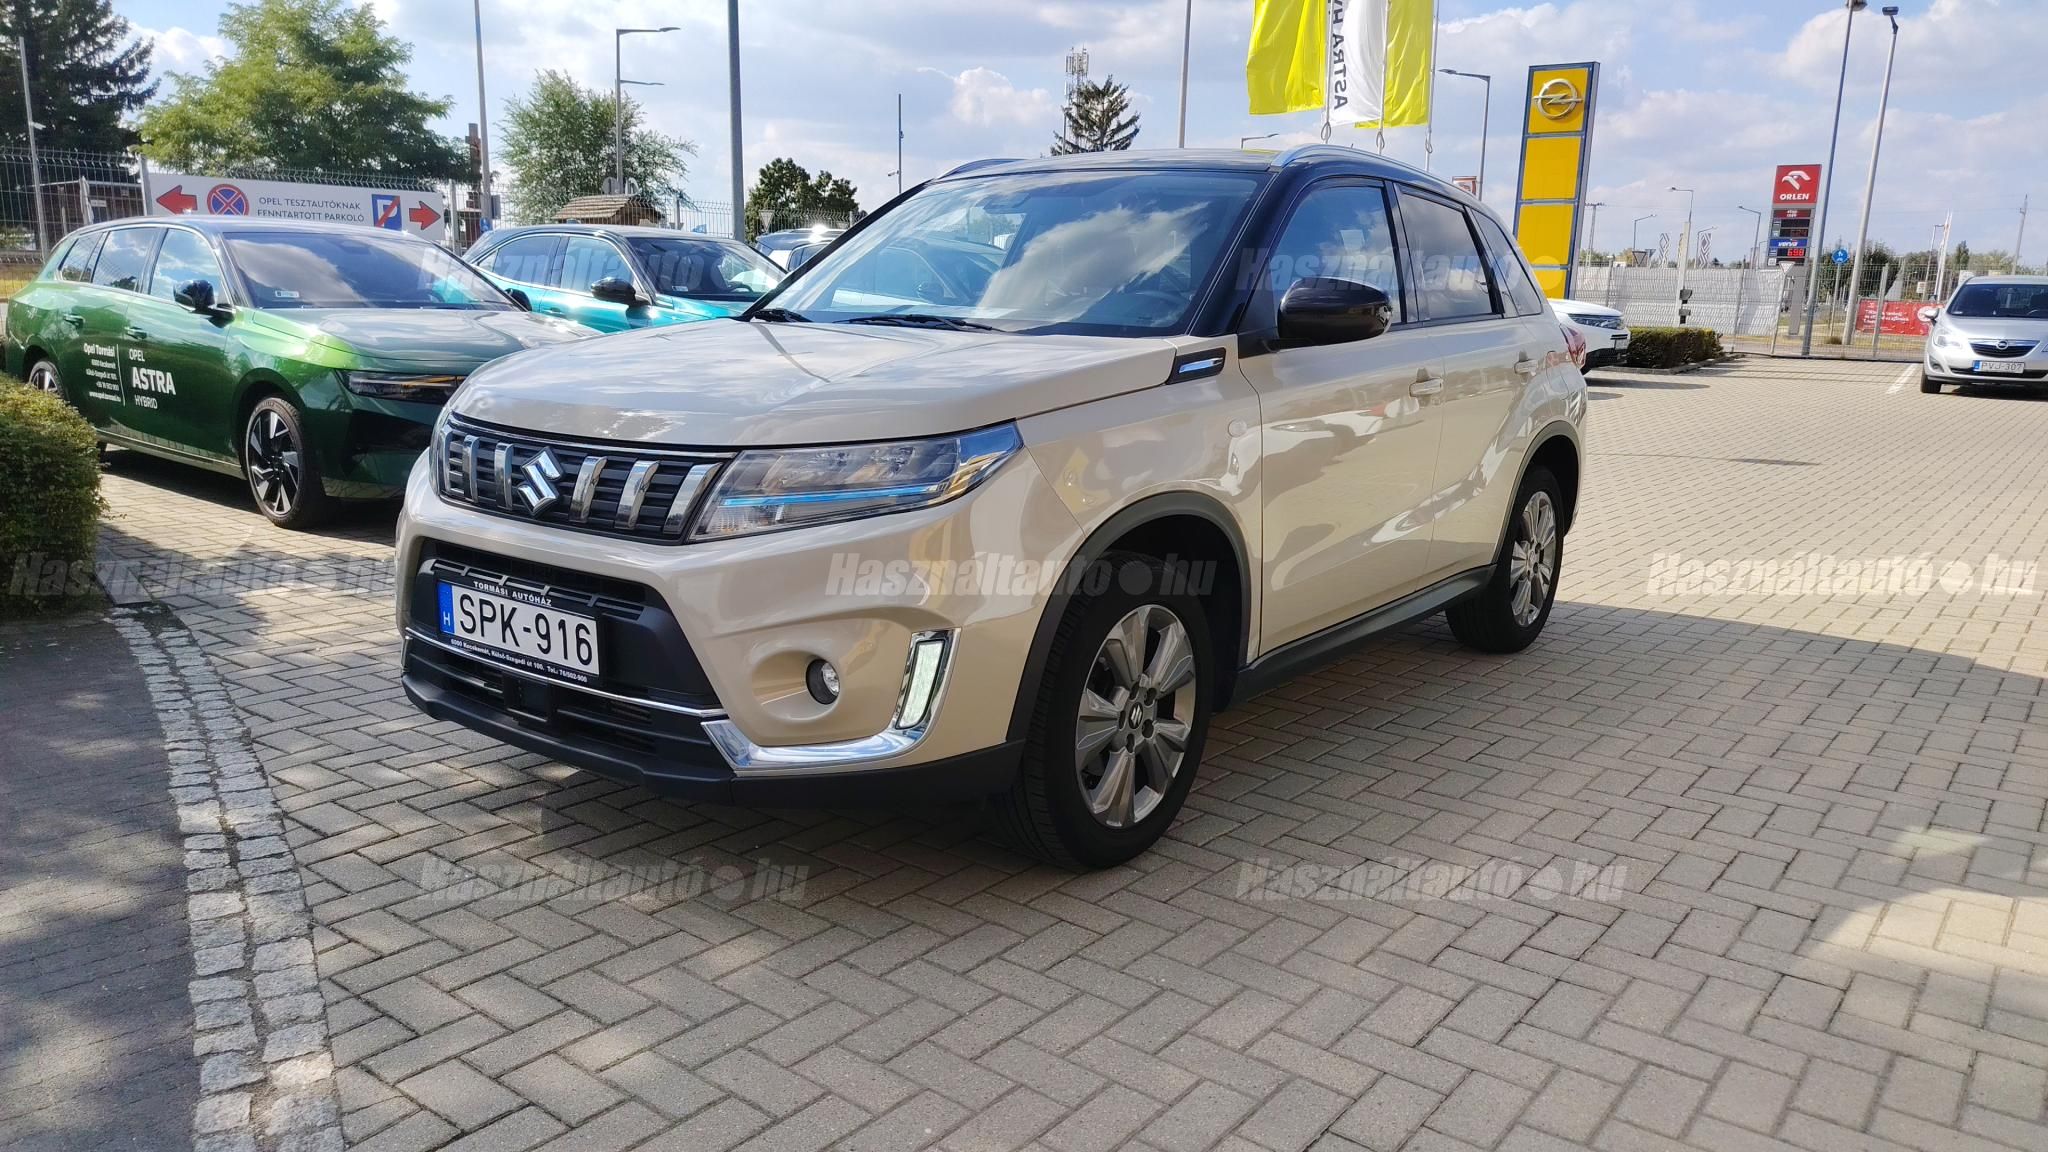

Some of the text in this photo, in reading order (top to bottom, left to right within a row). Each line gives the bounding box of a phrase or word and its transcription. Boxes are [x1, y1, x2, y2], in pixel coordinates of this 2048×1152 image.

[258, 197, 361, 211] OPEL TESZTAUTÓKNAK
[1779, 193, 1810, 201] ORLEN
[257, 209, 365, 223] FENNTARTOTT PARKOLÓ
[83, 343, 96, 355] Opel
[129, 348, 146, 362] OPEL
[1981, 362, 2022, 371] PVJ-307
[132, 366, 177, 396] ASTRA
[134, 395, 159, 409] HYBRID
[473, 581, 552, 607] TORMÁSI AUTÓHÁZ
[442, 611, 451, 626] H
[459, 593, 593, 666] SPK-916
